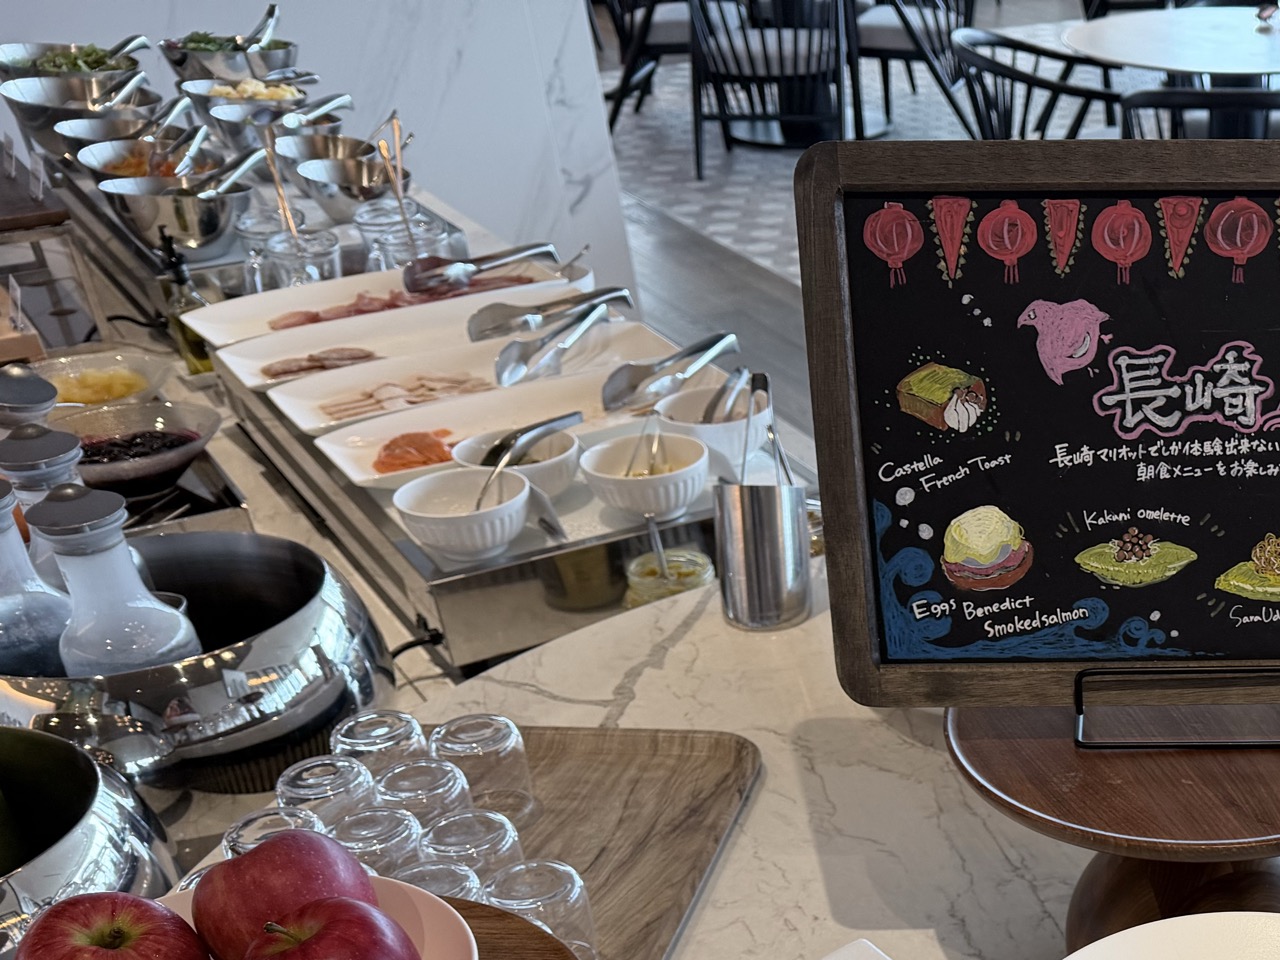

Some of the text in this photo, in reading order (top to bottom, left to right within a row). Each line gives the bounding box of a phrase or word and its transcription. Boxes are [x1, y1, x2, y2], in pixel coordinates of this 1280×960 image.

[1102, 351, 1266, 427] 長崎
[878, 454, 943, 482] Castella
[919, 453, 1012, 492] French Toast
[1083, 507, 1191, 531] Kakuni omelette
[912, 595, 1035, 621] Eggs Benedict
